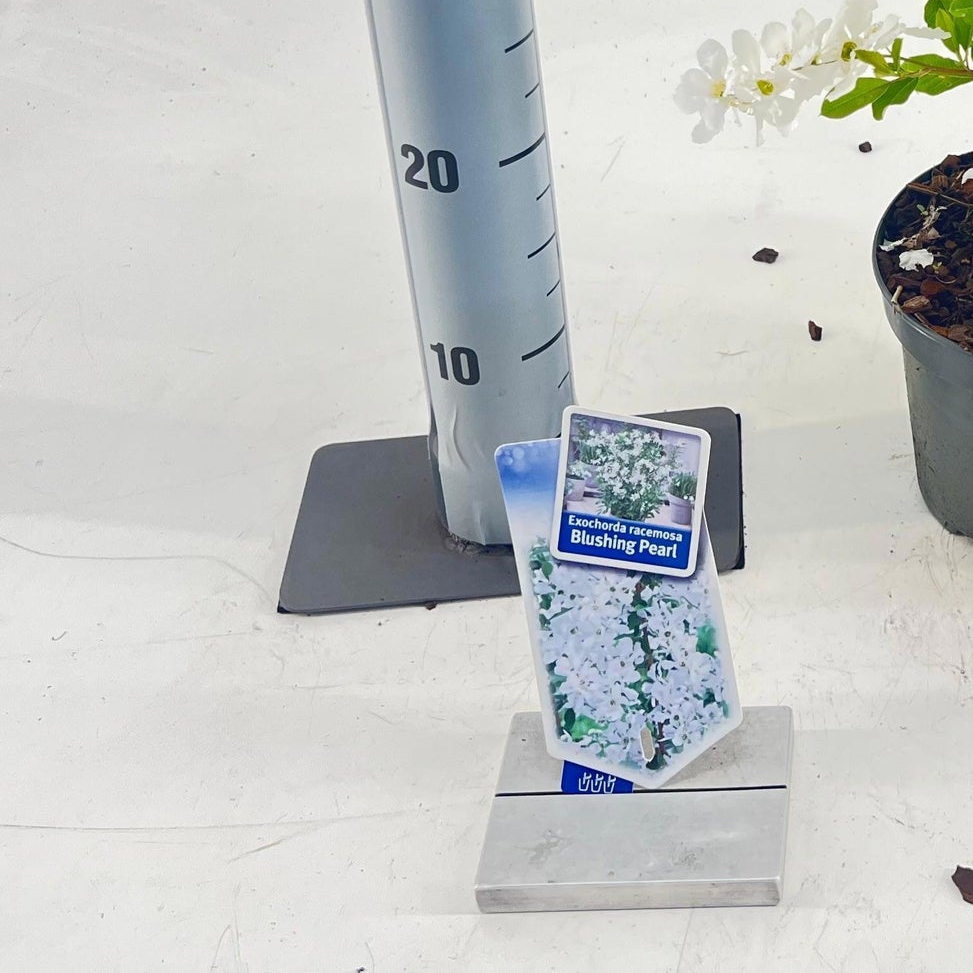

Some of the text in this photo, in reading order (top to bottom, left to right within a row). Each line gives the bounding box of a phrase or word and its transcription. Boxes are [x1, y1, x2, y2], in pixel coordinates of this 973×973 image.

[400, 143, 460, 194] 20
[430, 342, 480, 385] 10
[568, 514, 683, 542] Exochorda racemosa
[570, 529, 677, 559] Blushing Pearl
